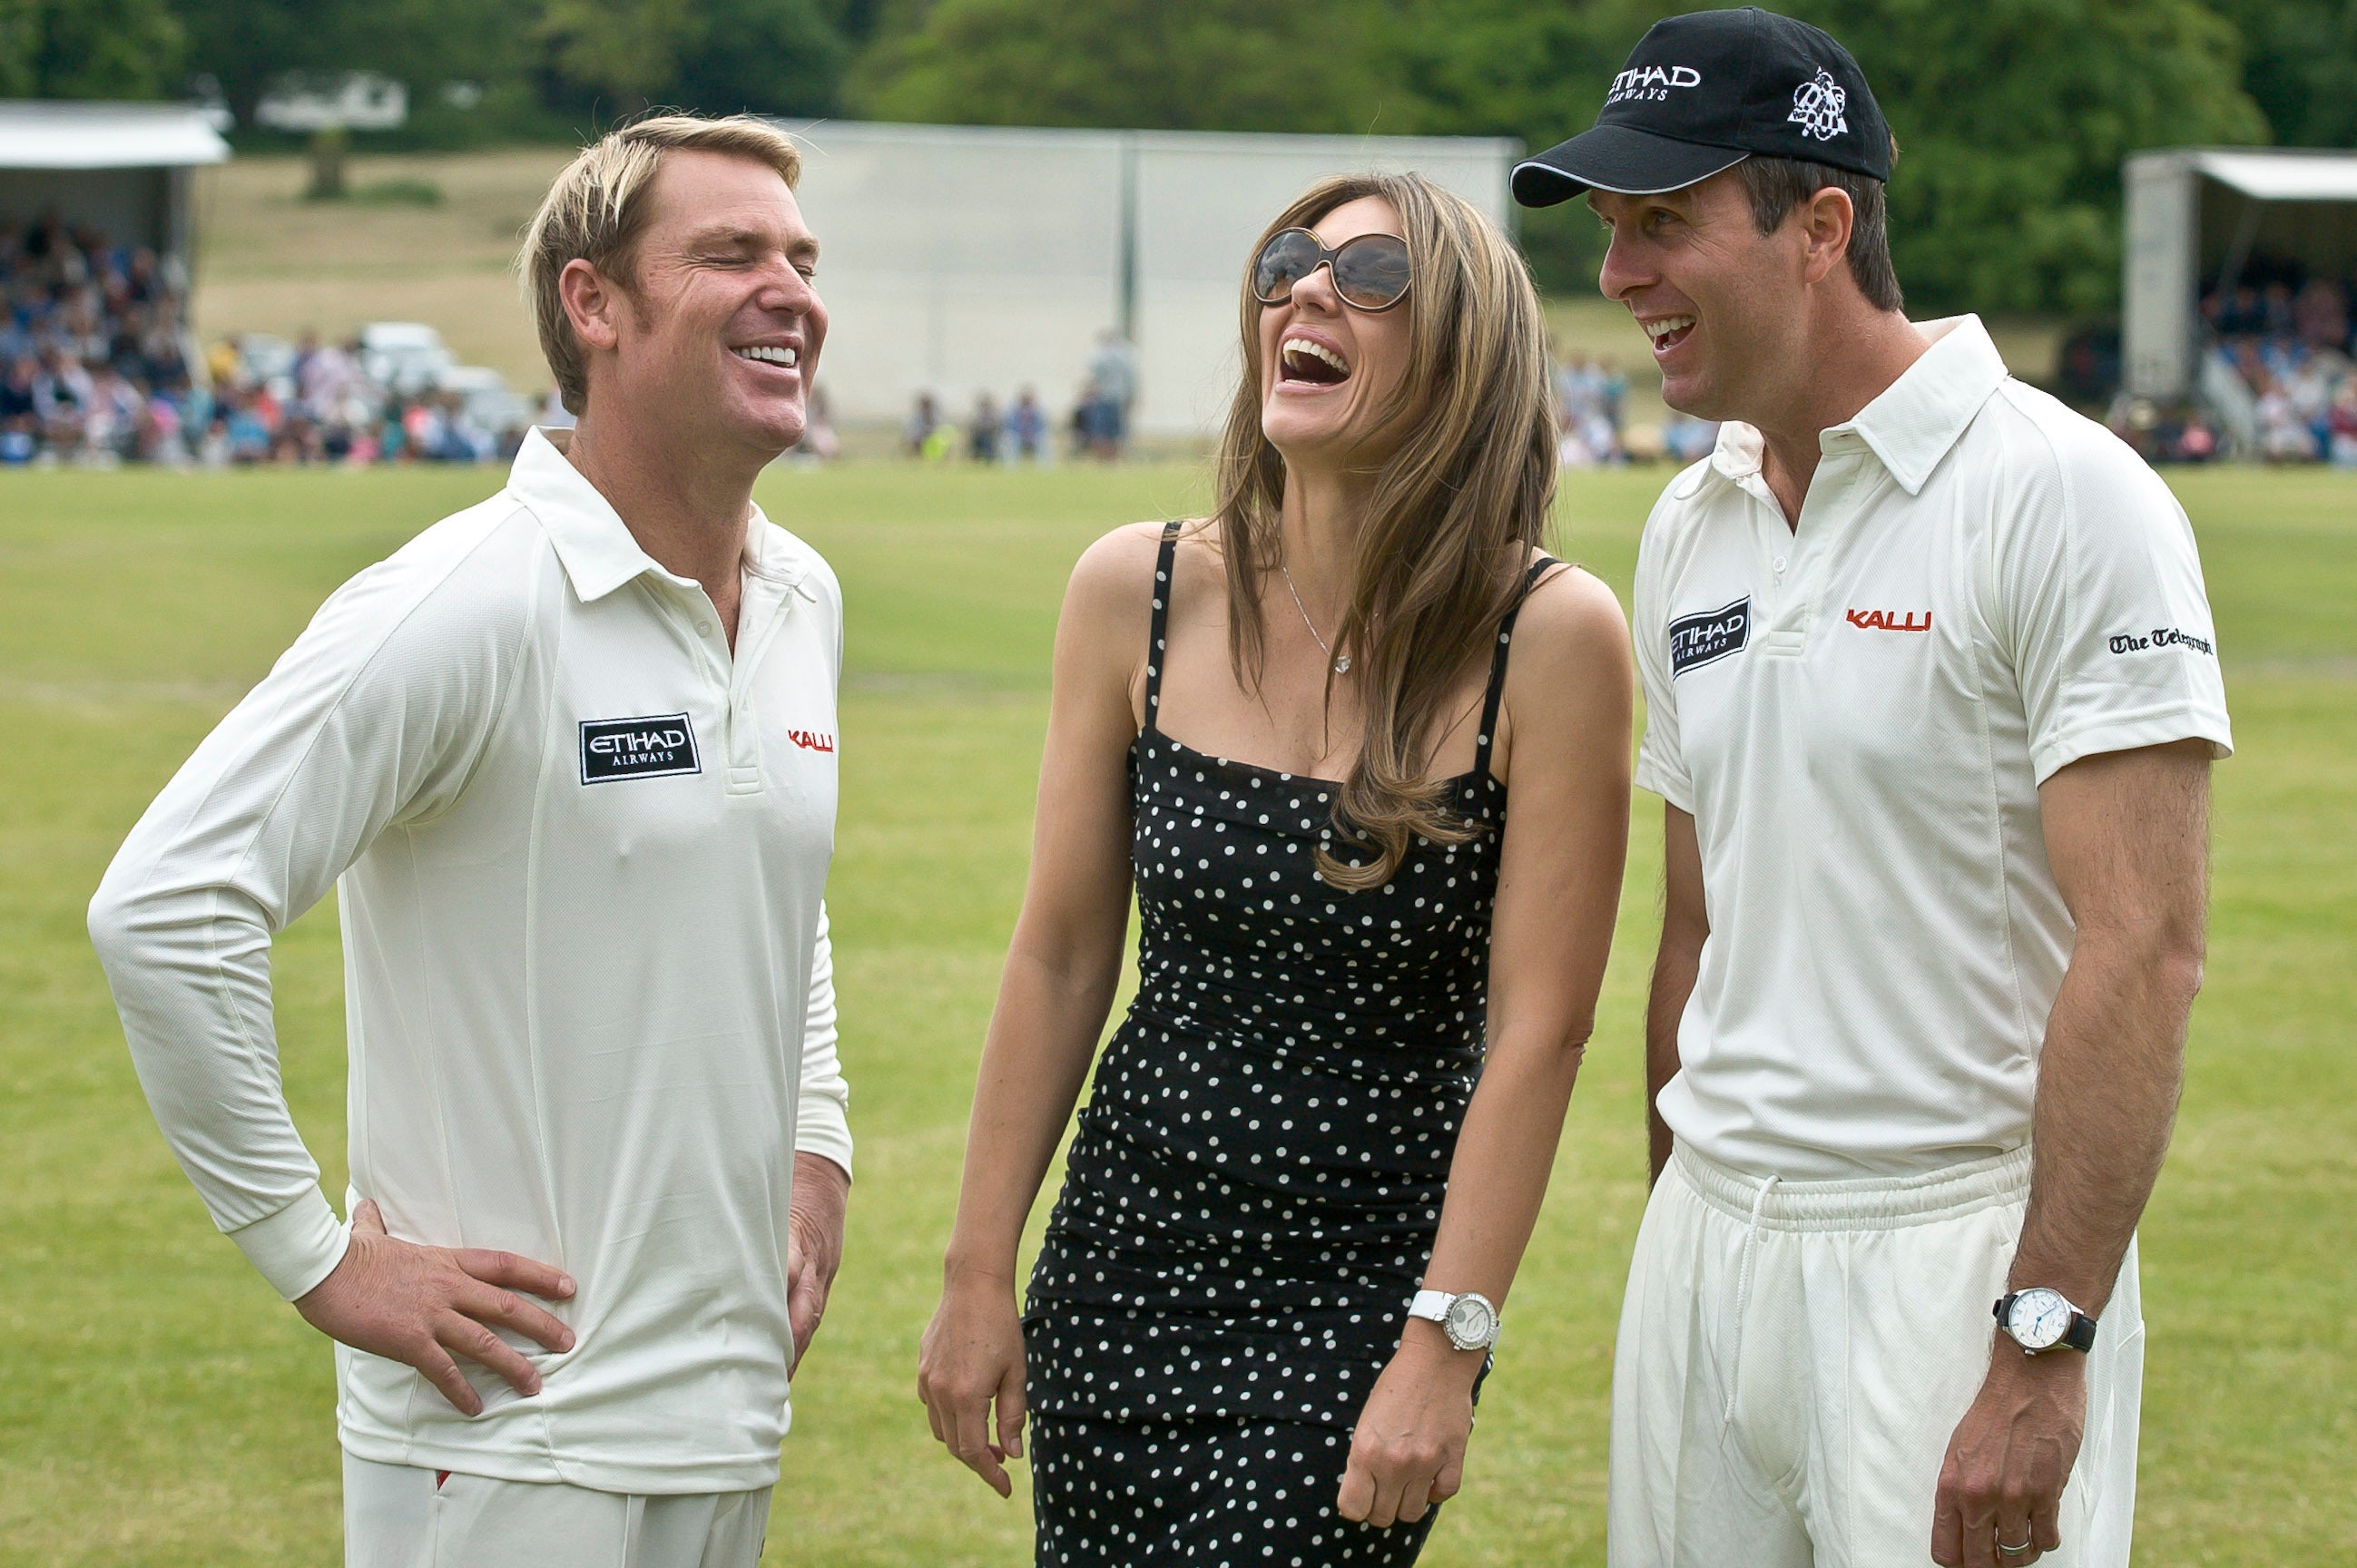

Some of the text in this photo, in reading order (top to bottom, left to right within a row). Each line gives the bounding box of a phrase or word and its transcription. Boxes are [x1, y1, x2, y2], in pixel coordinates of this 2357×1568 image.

[1675, 638, 1728, 662] AIRWAYS
[2109, 634, 2149, 654] The
[589, 730, 685, 753] ETIHAD
[612, 751, 674, 767] AIRWAYS
